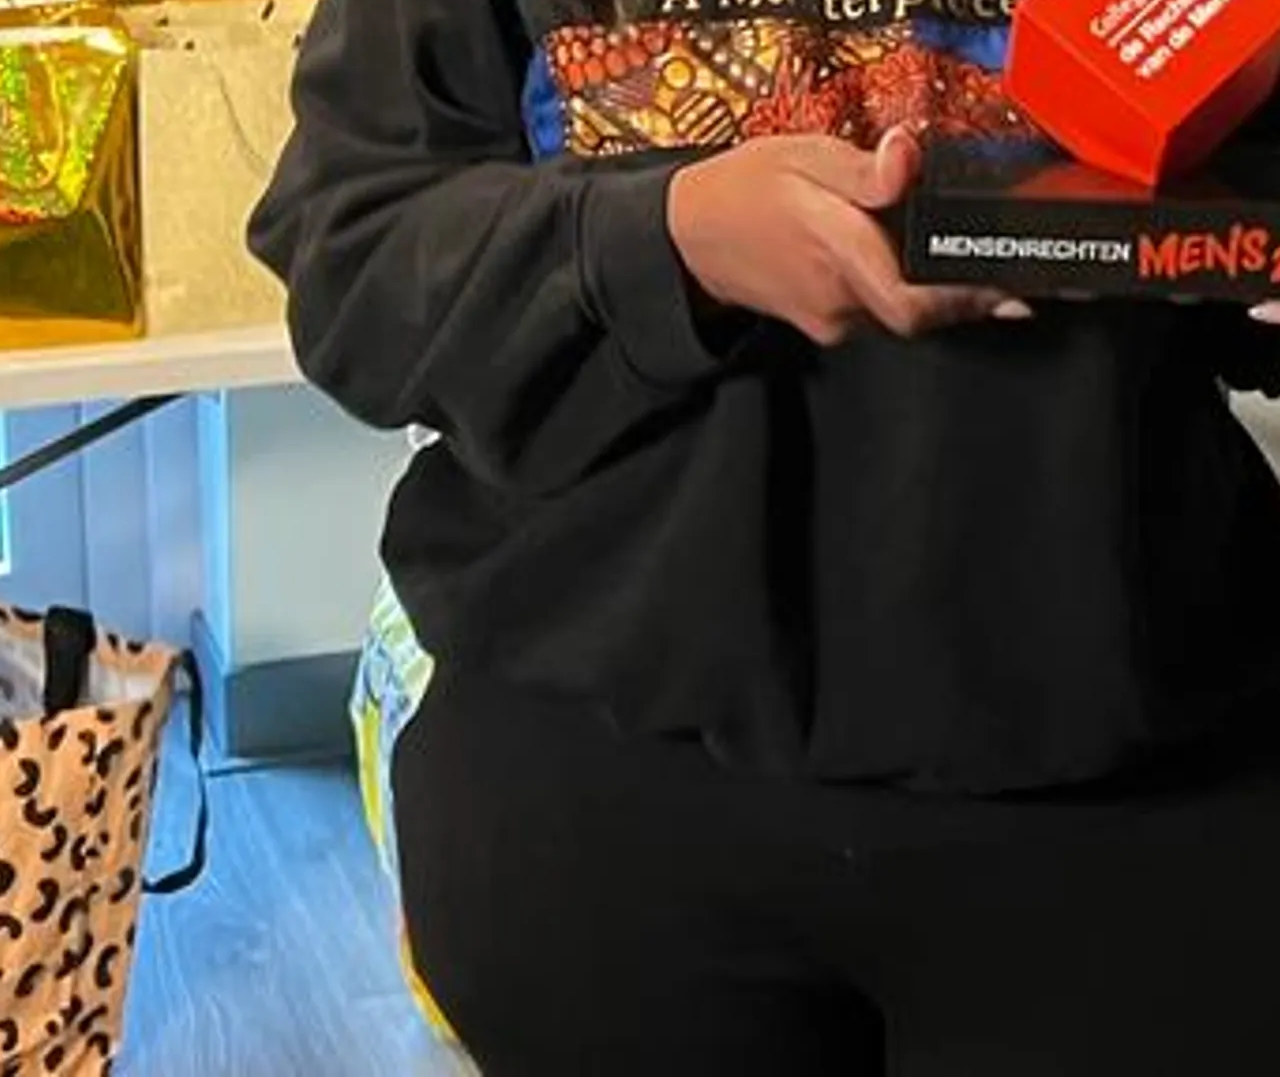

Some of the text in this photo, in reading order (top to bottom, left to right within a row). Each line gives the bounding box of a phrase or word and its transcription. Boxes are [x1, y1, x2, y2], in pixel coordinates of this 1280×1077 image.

[1120, 38, 1145, 64] de
[1135, 45, 1173, 79] van
[1169, 25, 1195, 50] de
[928, 234, 1133, 263] MENSENRECHTEN
[1136, 222, 1270, 280] MENS
